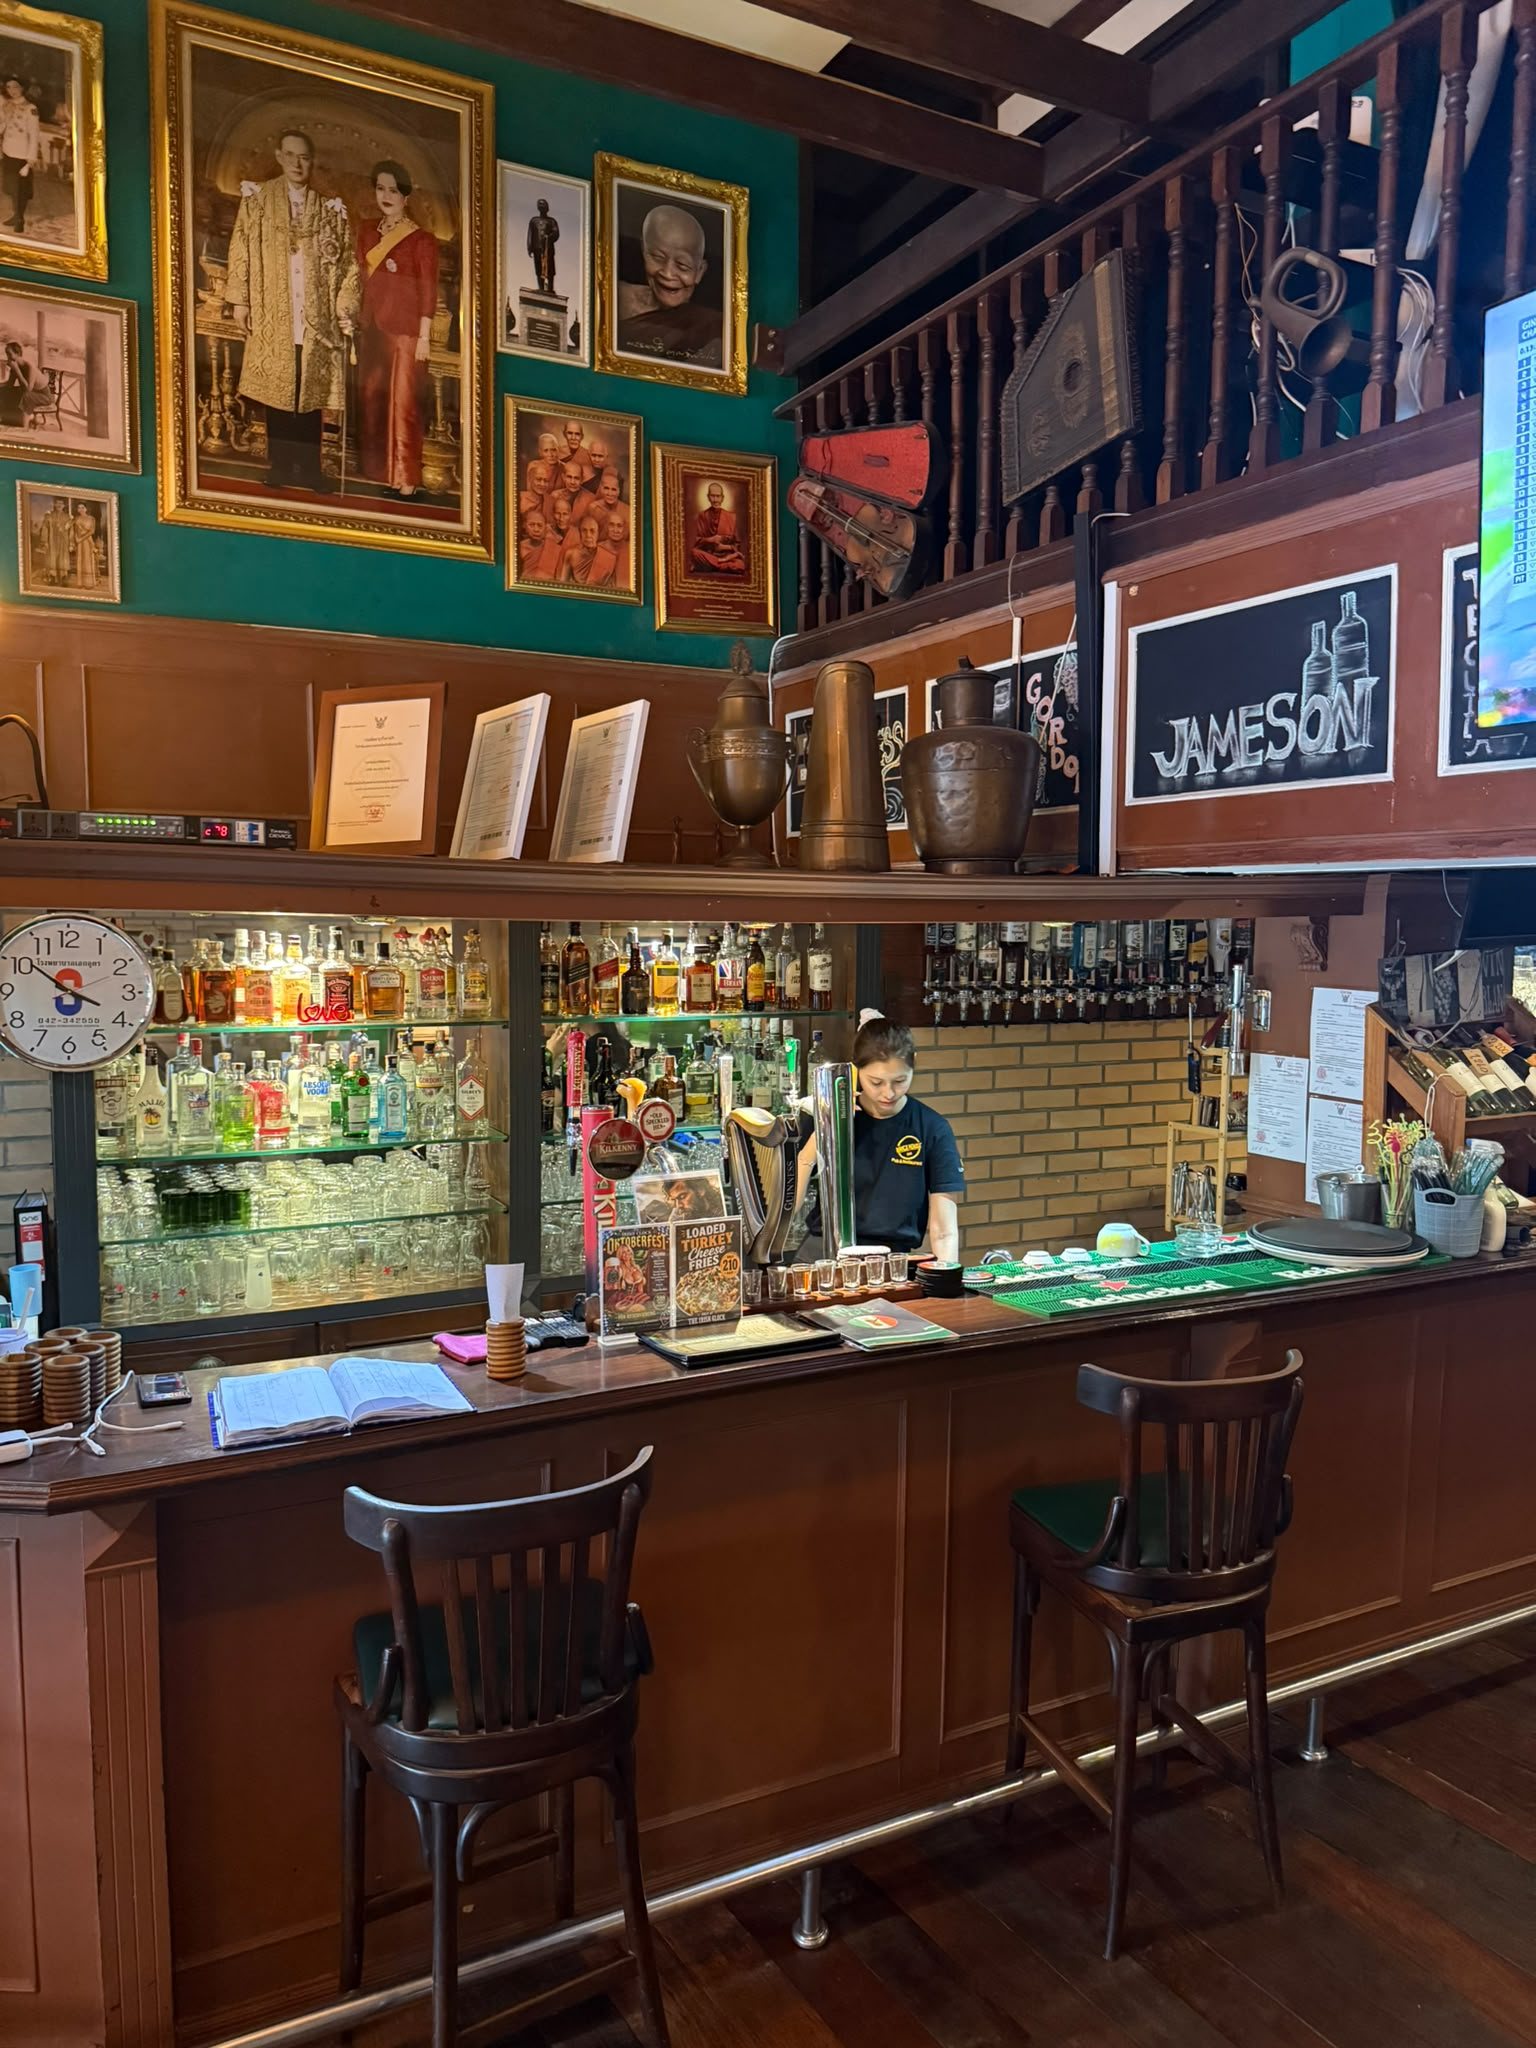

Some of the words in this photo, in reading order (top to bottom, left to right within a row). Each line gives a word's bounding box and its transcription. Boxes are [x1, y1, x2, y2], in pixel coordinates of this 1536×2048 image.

[1150, 677, 1380, 778] JAMESON
[33, 937, 51, 956] 11
[58, 930, 80, 949] 12
[96, 937, 103, 956] 1
[11, 956, 34, 975] 10
[112, 958, 128, 976] 2
[0, 982, 15, 1001] 9
[121, 983, 137, 1001] 3
[9, 1010, 25, 1029] 8
[111, 1010, 127, 1028] 4
[32, 1029, 48, 1047] 7
[61, 1036, 77, 1054] 6
[91, 1029, 107, 1047] 5
[573, 1048, 582, 1091] KILKENNY
[600, 1143, 638, 1155] KILKENNY
[784, 1160, 796, 1211] GUINNESS
[686, 1223, 726, 1239] LOADED
[607, 1233, 667, 1255] OKTOBERFEST
[681, 1231, 734, 1253] TURKEY
[688, 1245, 726, 1261] Cheese
[688, 1255, 720, 1271] FRIES
[722, 1258, 738, 1271] 210
[1060, 1280, 1225, 1308] Heineken
